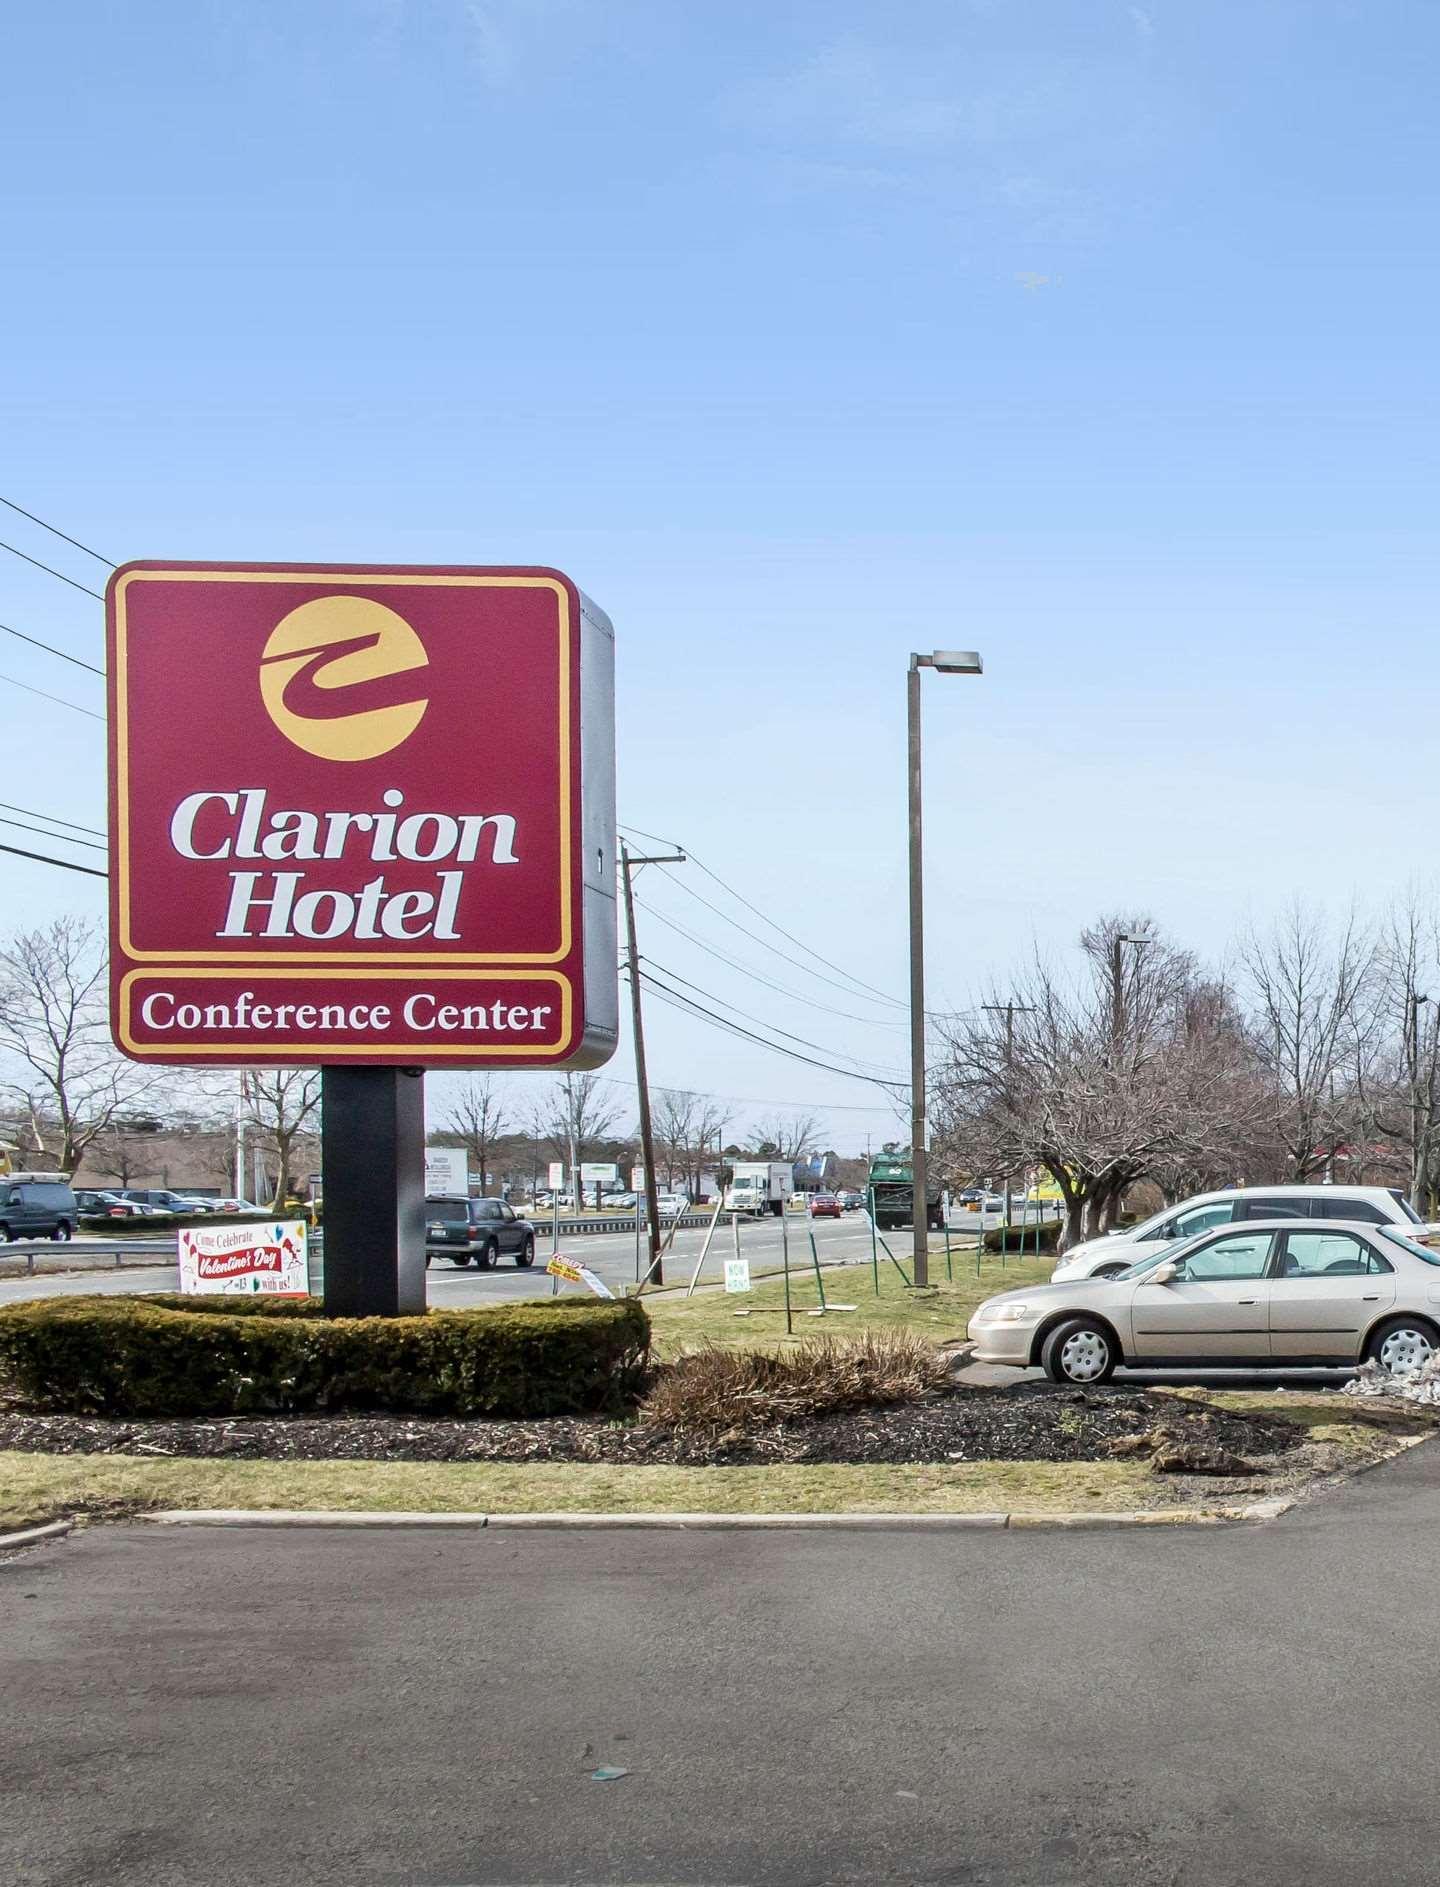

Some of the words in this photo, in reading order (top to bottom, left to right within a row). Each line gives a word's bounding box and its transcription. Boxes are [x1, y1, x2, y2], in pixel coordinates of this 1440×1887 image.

[169, 788, 519, 864] Clarion
[214, 870, 464, 940] Hotel
[142, 991, 392, 1031] Conference
[402, 992, 551, 1031] Center
[216, 1231, 253, 1248] Celebrate
[200, 1250, 251, 1276] Valentine's
[253, 1247, 277, 1270] Day
